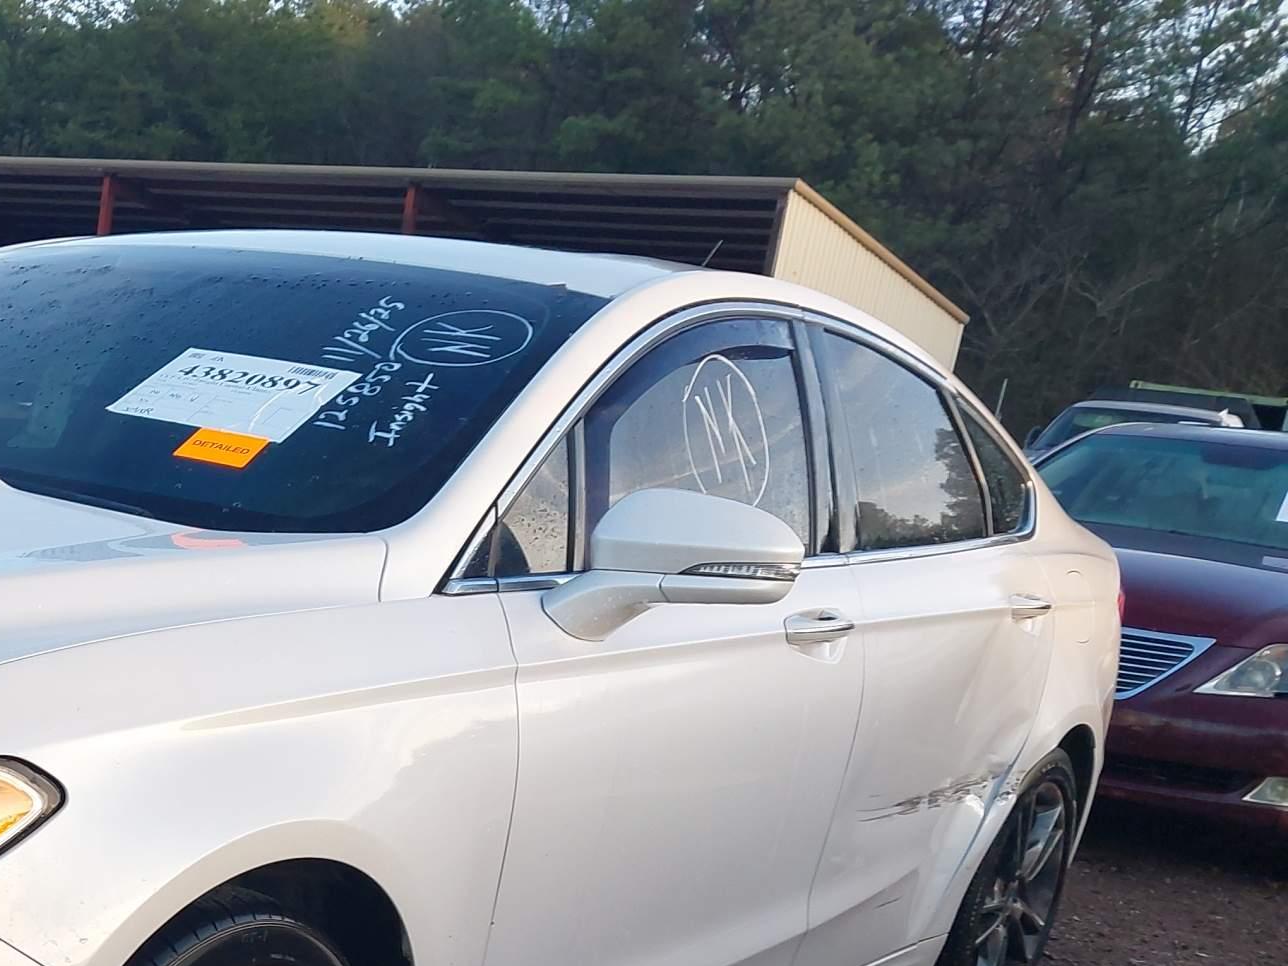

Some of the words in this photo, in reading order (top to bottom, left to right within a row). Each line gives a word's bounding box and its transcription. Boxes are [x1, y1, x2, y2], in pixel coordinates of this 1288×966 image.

[321, 295, 405, 361] 11/26/25
[420, 321, 501, 358] NK
[178, 364, 321, 395] 43820897
[367, 373, 440, 447] Insight
[192, 439, 250, 455] DETAILED
